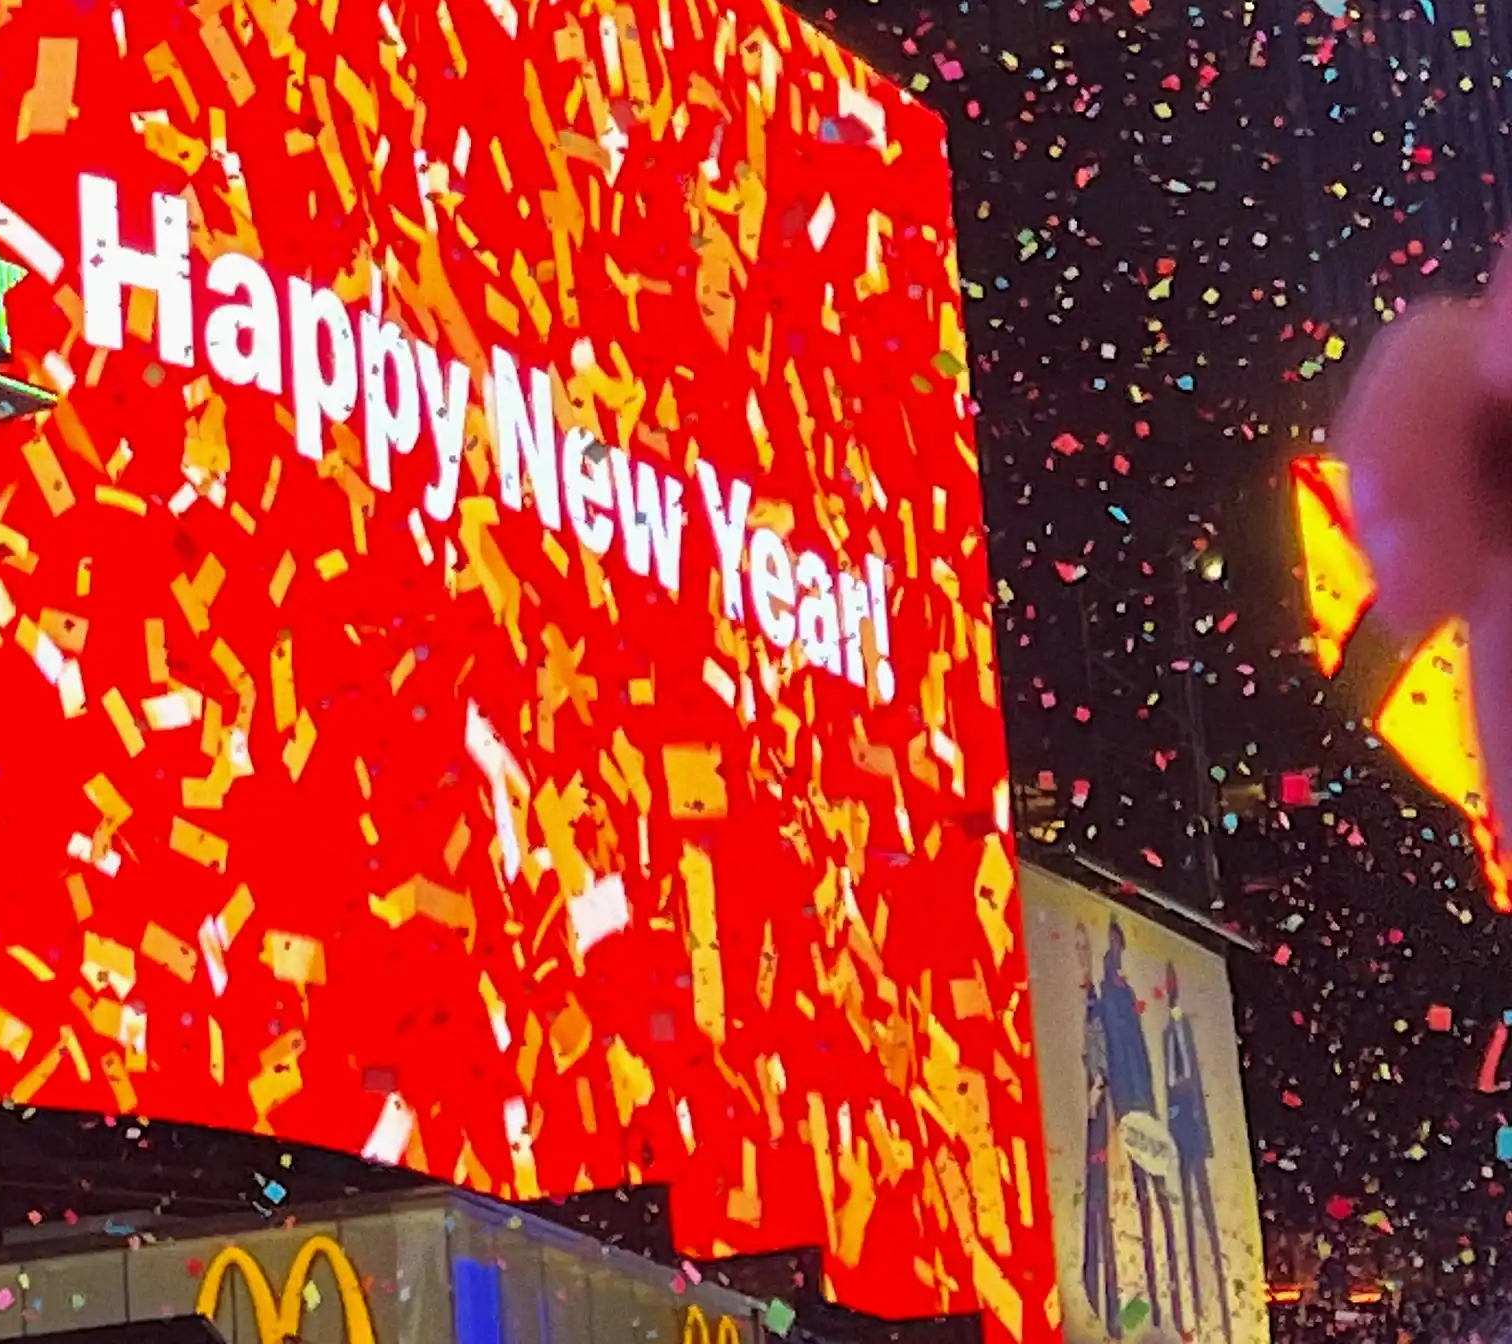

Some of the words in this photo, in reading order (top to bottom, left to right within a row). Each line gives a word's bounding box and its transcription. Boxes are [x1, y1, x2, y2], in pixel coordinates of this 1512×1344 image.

[78, 172, 468, 520] Happy
[488, 346, 684, 593] New
[695, 459, 895, 705] Year!
